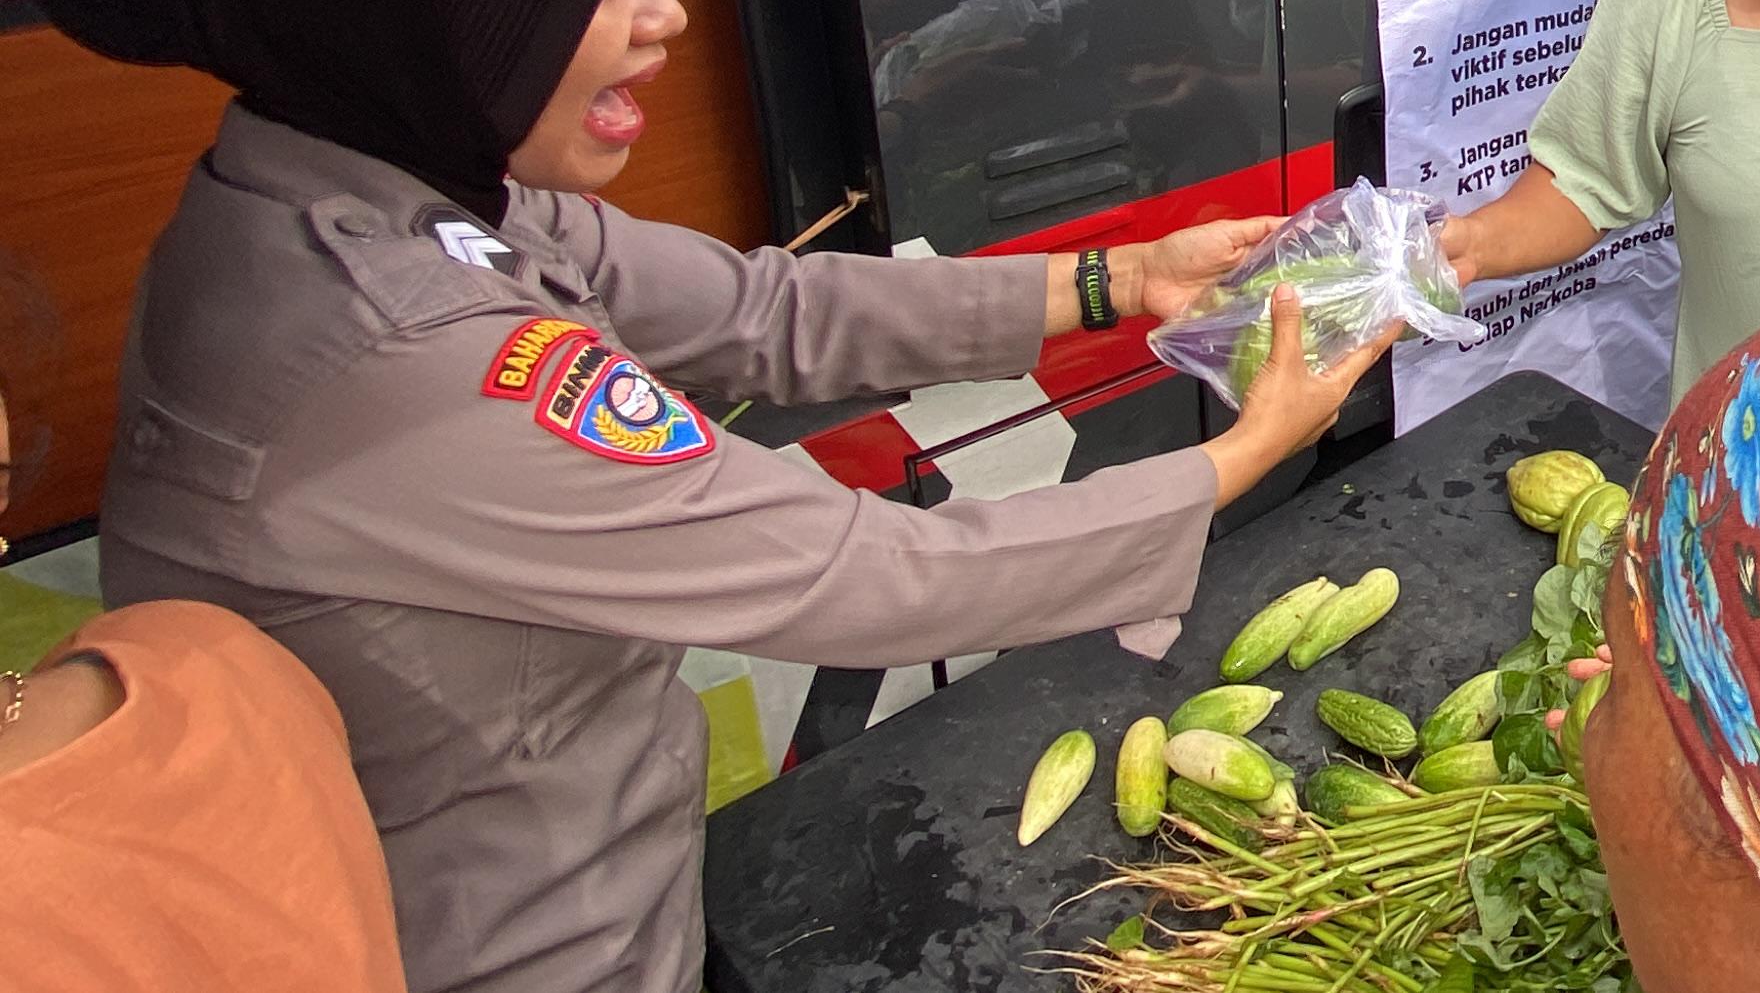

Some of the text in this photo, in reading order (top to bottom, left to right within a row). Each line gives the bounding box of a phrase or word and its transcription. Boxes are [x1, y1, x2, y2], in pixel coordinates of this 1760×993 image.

[1412, 45, 1434, 67] 2.
[1451, 20, 1528, 56] Jangan
[1450, 33, 1587, 84] viktif sebelu
[1451, 65, 1571, 117] pihak terka
[1419, 129, 1528, 183] 3. Jangan
[1457, 153, 1534, 197] KTP tan
[1518, 274, 1553, 301] dan
[1610, 222, 1675, 259] pereda
[1458, 276, 1597, 353] lap Narkoba
